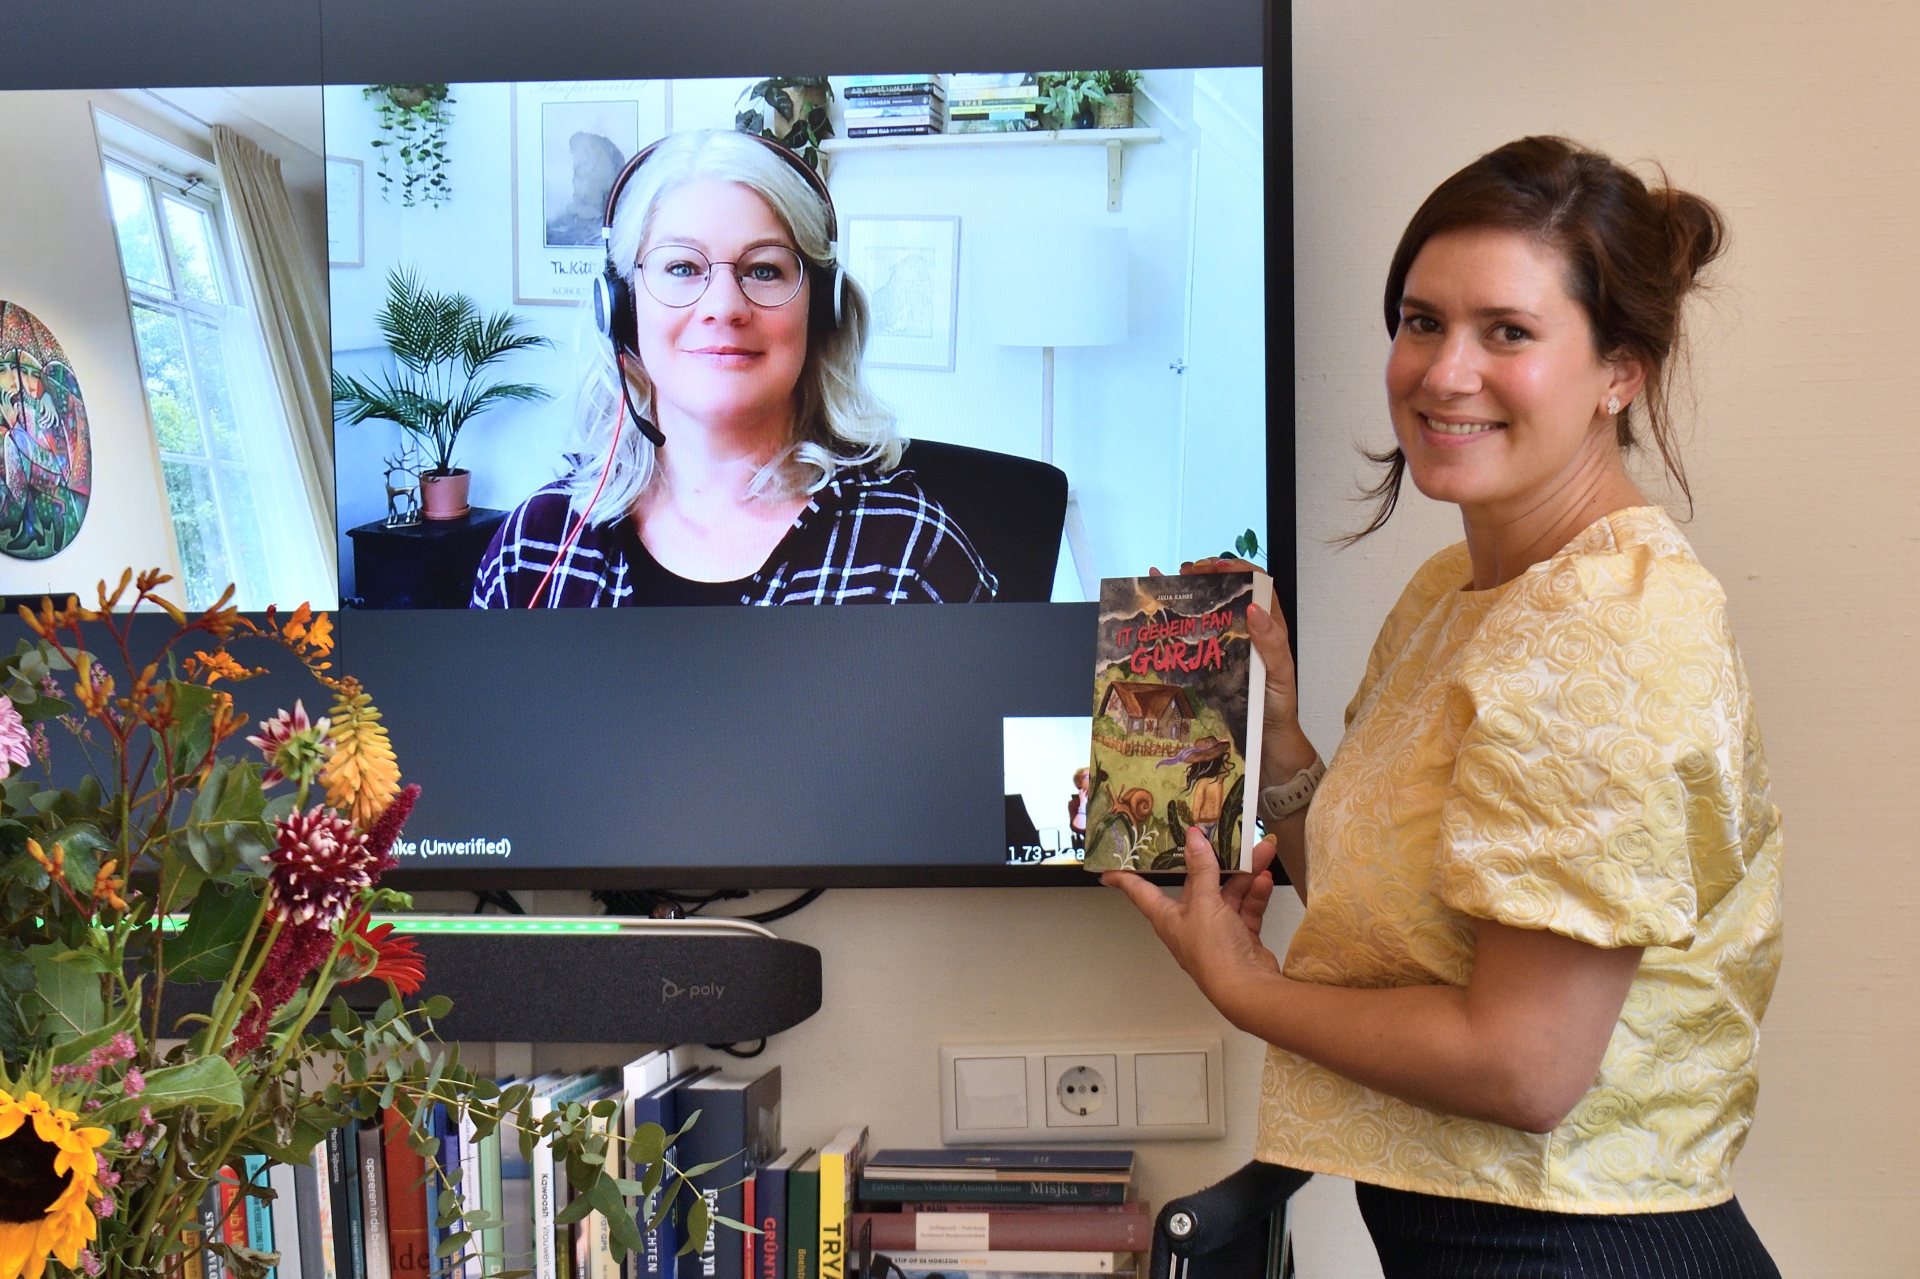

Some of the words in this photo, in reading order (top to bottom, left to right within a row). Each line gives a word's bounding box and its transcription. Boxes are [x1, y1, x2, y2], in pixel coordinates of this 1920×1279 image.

[1117, 627, 1133, 646] IT
[1137, 616, 1196, 642] GEHEIM
[1201, 611, 1232, 633] FAN
[1130, 637, 1221, 676] GURJA
[420, 838, 512, 858] (Unverified)
[1009, 846, 1042, 861] 1.73
[690, 983, 724, 999] poly
[365, 1158, 377, 1206] opereren
[872, 1183, 905, 1192] Edward
[961, 1184, 992, 1192] Anoush
[995, 1184, 1021, 1192] Elman
[1030, 1182, 1078, 1197] Misjka
[541, 1173, 549, 1217] Kawoosh
[370, 1207, 379, 1216] in
[370, 1218, 382, 1231] de
[542, 1225, 550, 1264] Vrouwen
[700, 1255, 715, 1276] yn
